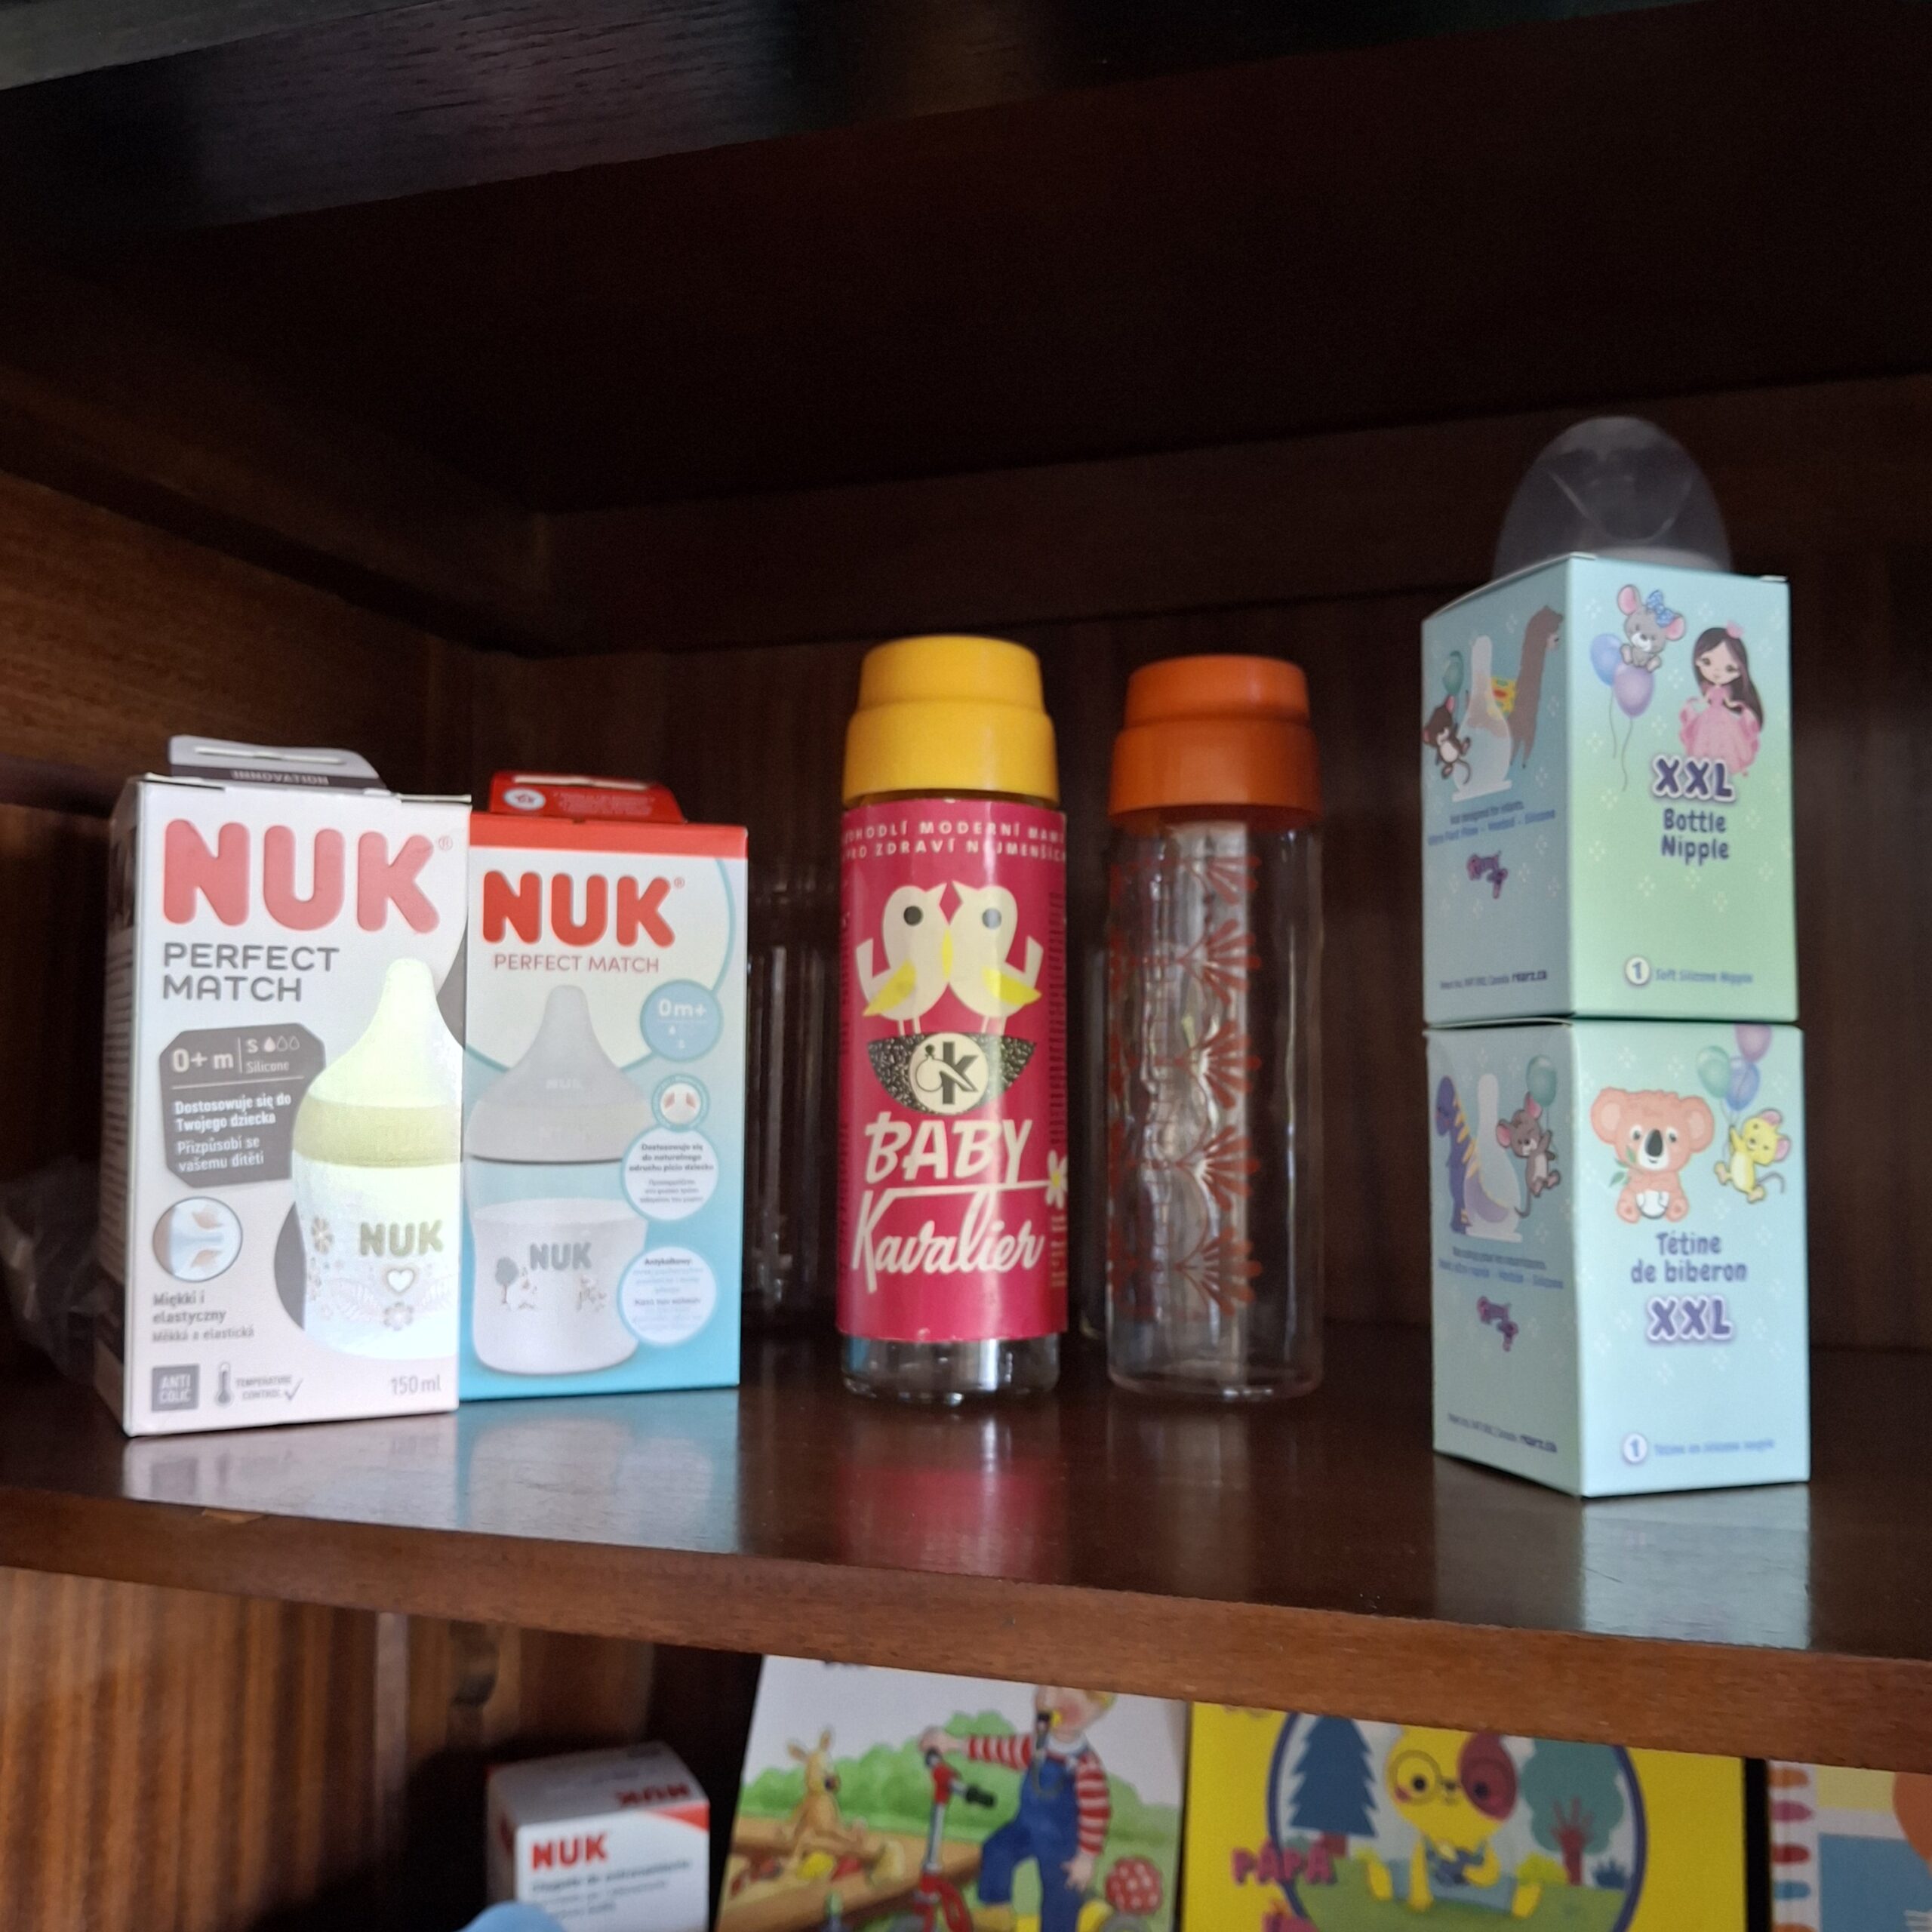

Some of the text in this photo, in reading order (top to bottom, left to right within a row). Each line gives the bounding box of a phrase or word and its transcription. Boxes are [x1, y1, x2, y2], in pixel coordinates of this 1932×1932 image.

[230, 770, 330, 786] INNOVATION
[1654, 756, 1735, 801] XXL
[918, 820, 1020, 835] MODERNÍ
[1664, 808, 1727, 832] Bottle
[875, 839, 955, 857] ZDRAVÍ
[1662, 835, 1730, 866] Nipple
[164, 943, 339, 972] PERFECT
[494, 954, 659, 973] PERFECT MATCH
[1632, 962, 1643, 980] 1
[162, 975, 302, 1001] MATCH
[247, 1038, 259, 1054] S
[246, 1061, 290, 1074] Silicone
[175, 1093, 291, 1115] Dostosowuje się do
[177, 1111, 275, 1133] Twojego dziecka
[246, 1138, 260, 1148] se
[865, 1111, 1032, 1186] BABY
[358, 1220, 442, 1257] NUK
[851, 1187, 1044, 1294] Kavalier
[1657, 1232, 1721, 1256] Tétine
[529, 1243, 592, 1271] NUK
[1631, 1258, 1747, 1283] de biberon
[153, 1311, 226, 1325] elastyczny
[1647, 1296, 1733, 1339] XXL
[161, 1374, 191, 1389] ANTI
[158, 1389, 192, 1404] COLIC
[532, 1832, 608, 1870] NUK
[1231, 1835, 1339, 1885] PAPA
